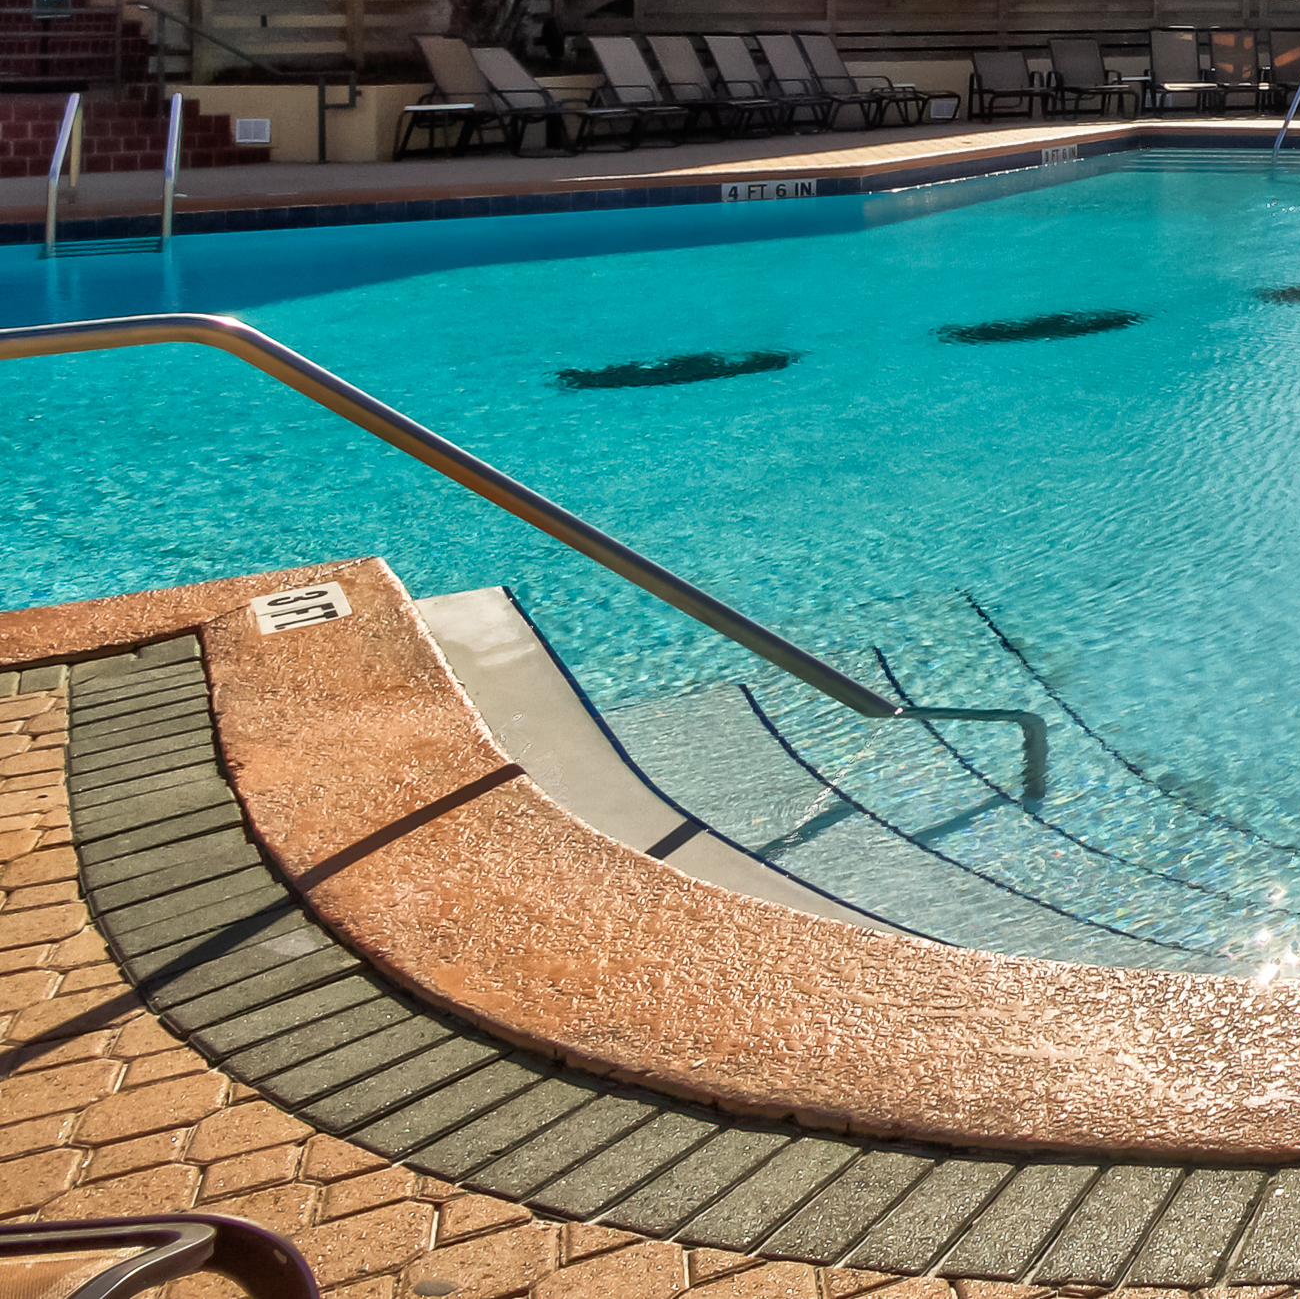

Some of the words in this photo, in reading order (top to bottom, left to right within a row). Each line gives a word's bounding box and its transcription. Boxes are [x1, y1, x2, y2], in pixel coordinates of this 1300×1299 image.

[1062, 148, 1067, 160] 6
[728, 185, 739, 201] 4
[747, 183, 768, 199] FT
[775, 183, 787, 197] 6
[267, 590, 329, 607] 3
